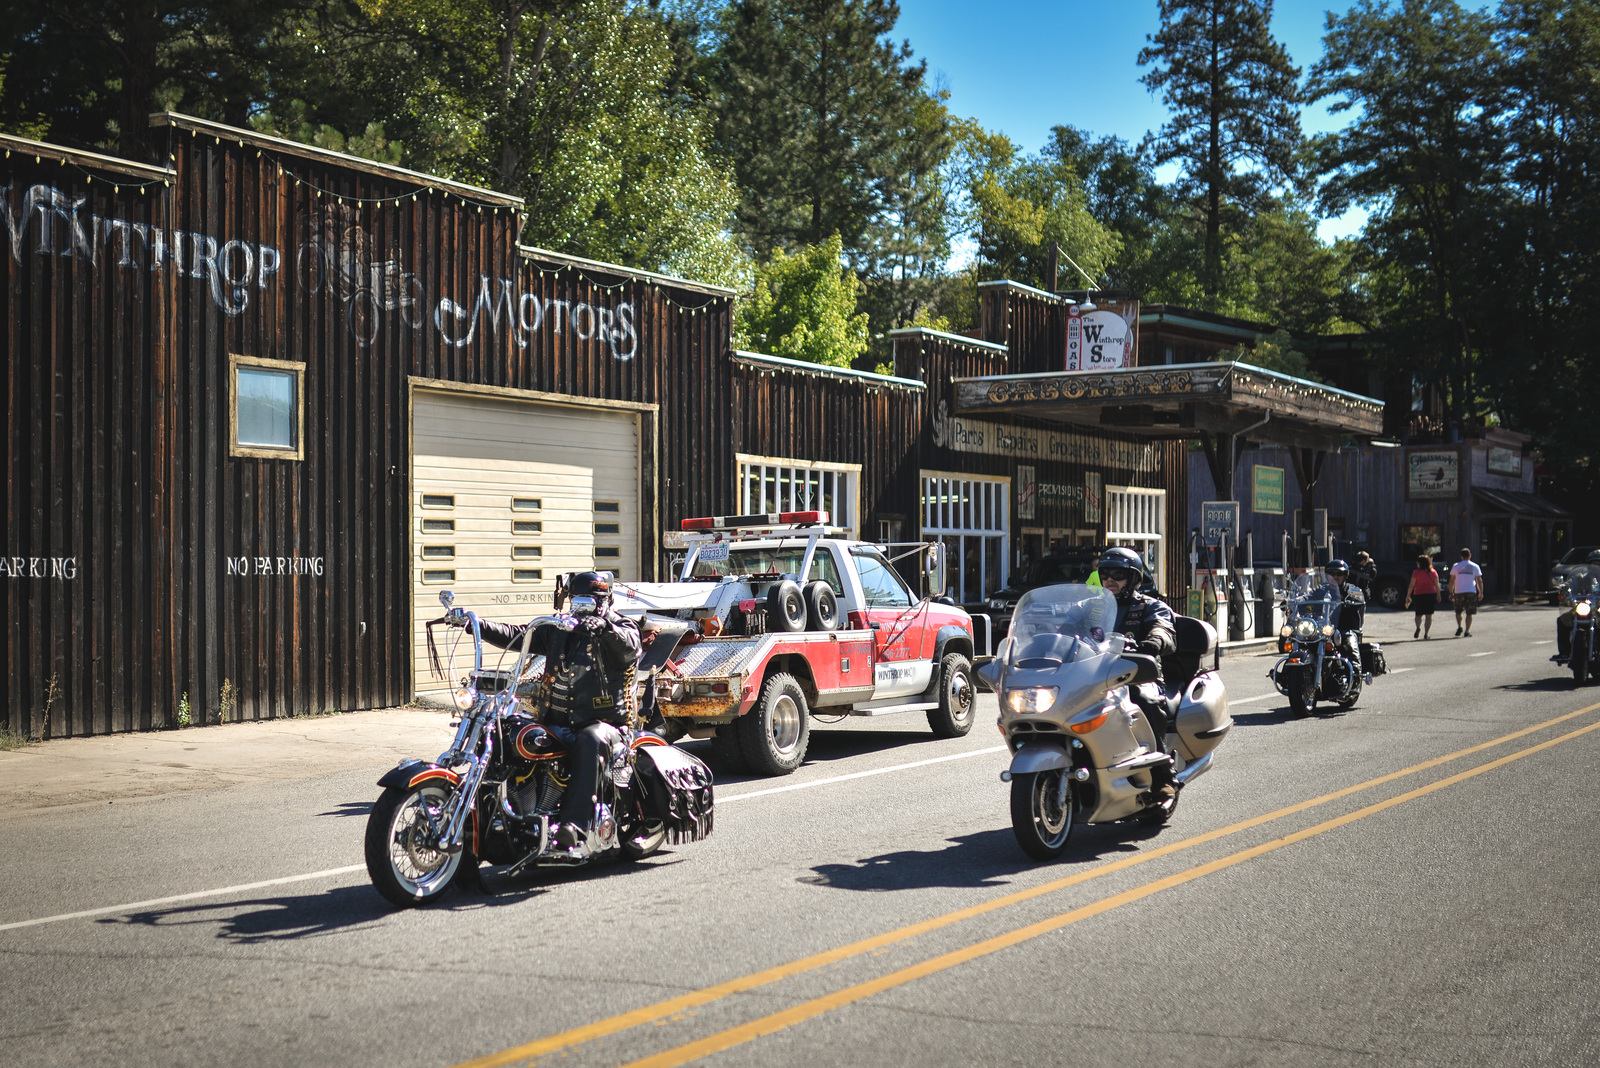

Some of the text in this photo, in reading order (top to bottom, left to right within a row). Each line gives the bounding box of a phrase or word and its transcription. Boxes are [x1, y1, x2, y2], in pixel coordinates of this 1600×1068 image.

[0, 184, 281, 317] WINTHROP
[434, 273, 638, 361] MOTORS
[1083, 325, 1125, 345] Winthrop
[1069, 341, 1078, 370] GAS
[1090, 344, 1117, 363] Store
[955, 422, 984, 446] Parts
[1038, 483, 1083, 500] PROVISIONS
[227, 556, 324, 578] NO PARKING
[495, 593, 554, 604] NO PARKIN
